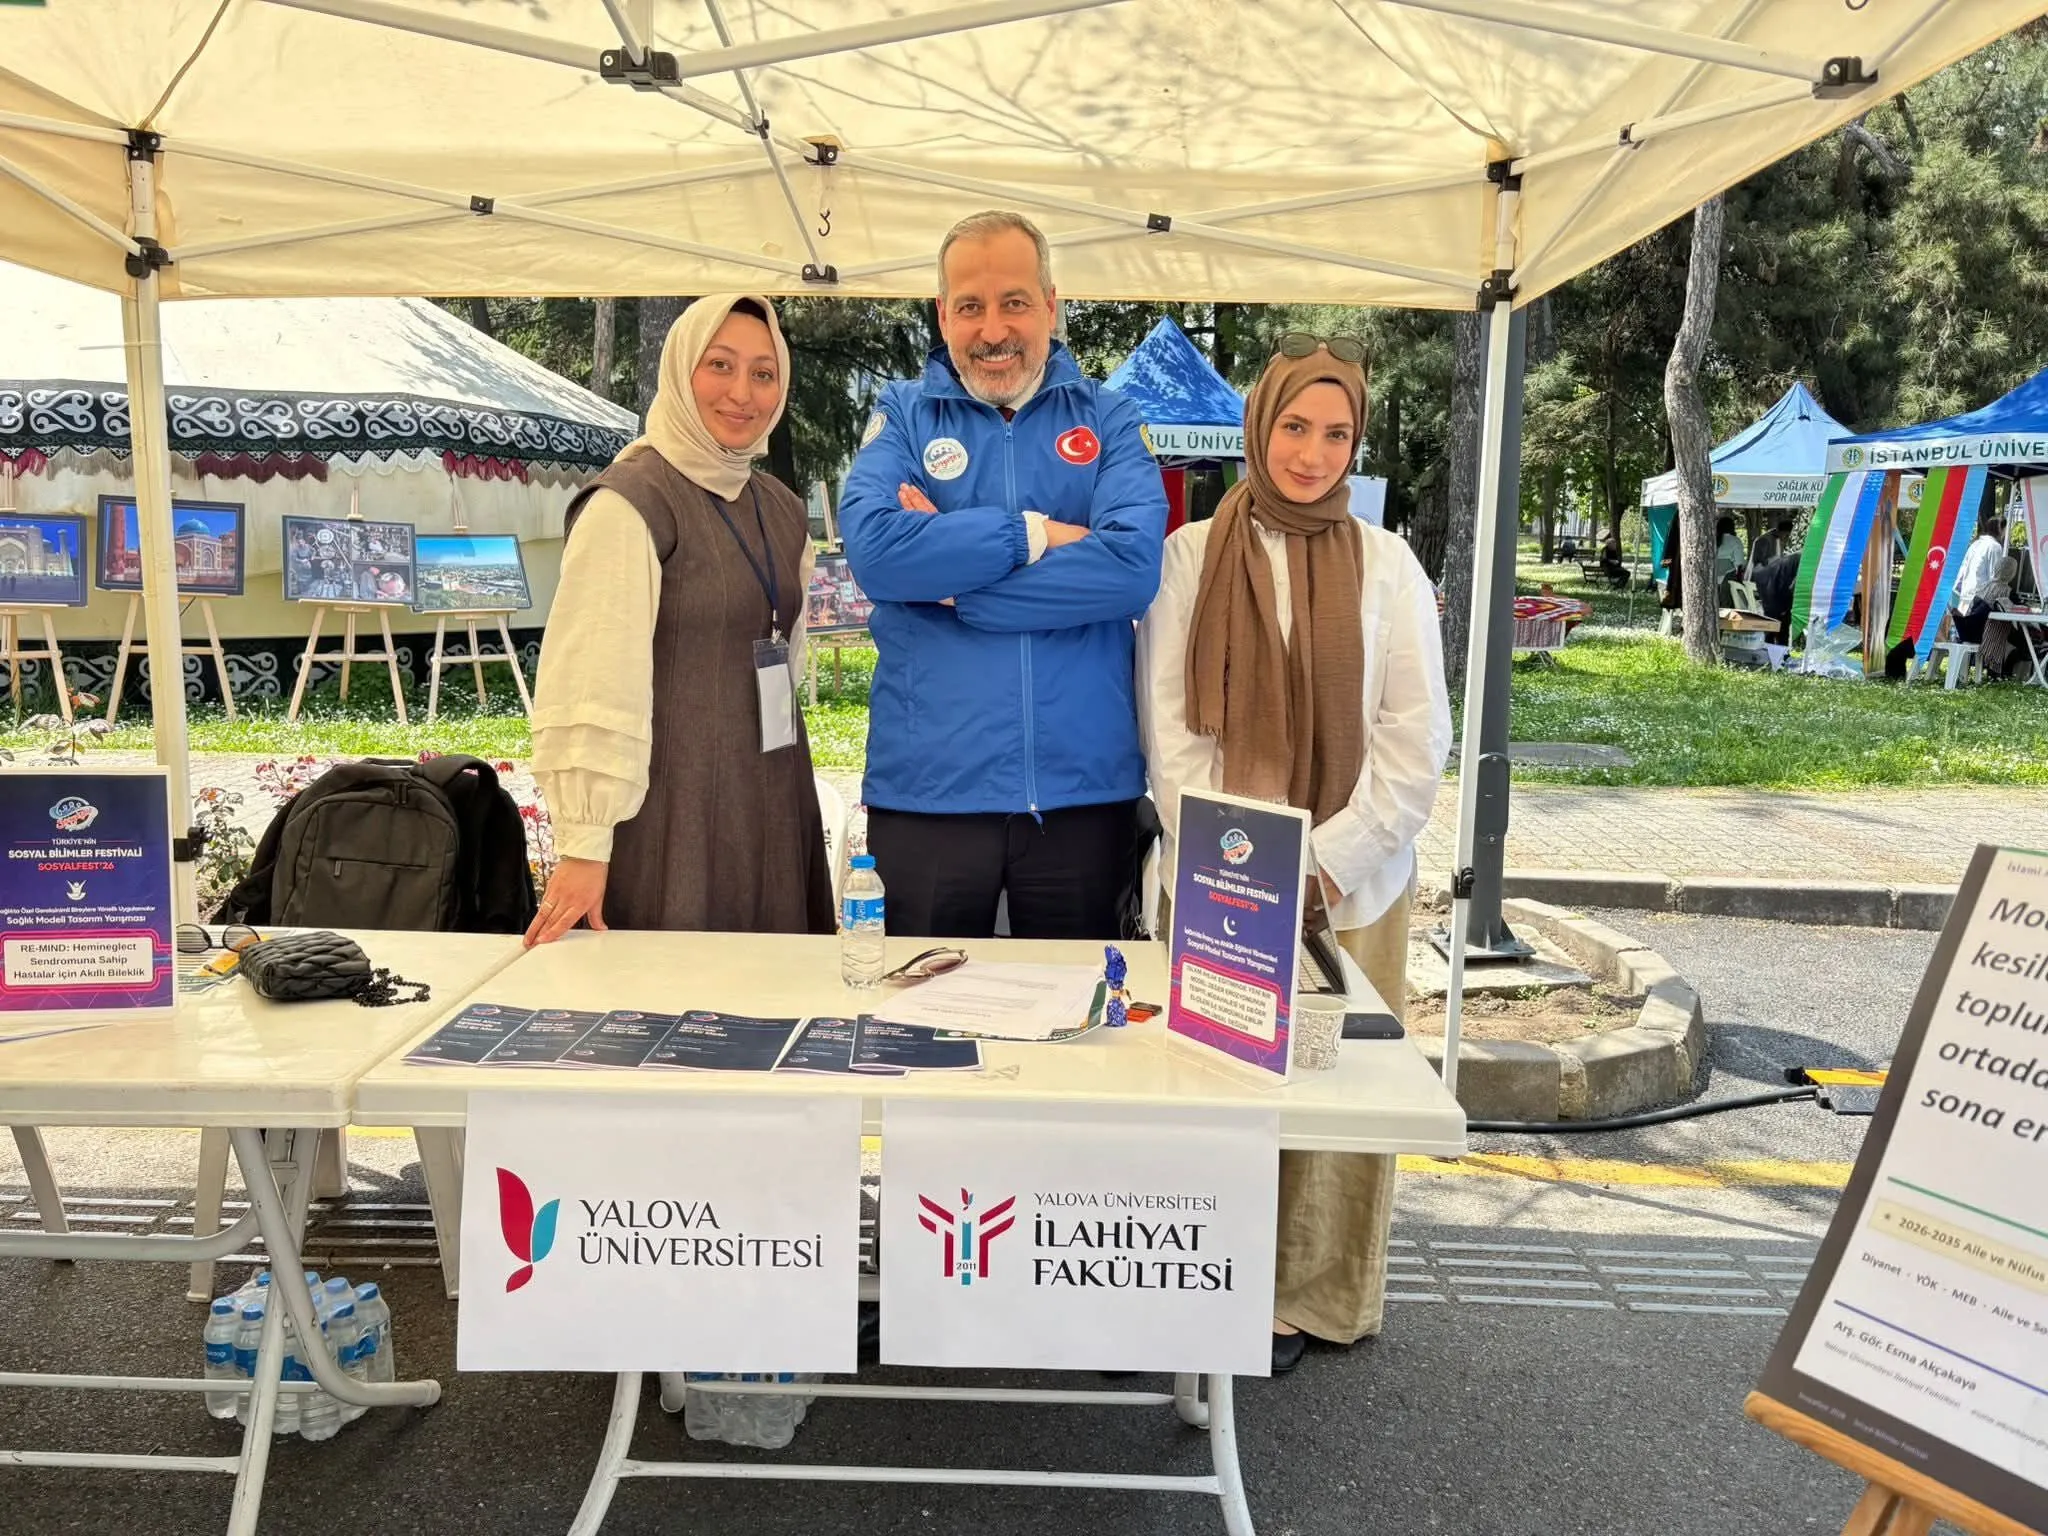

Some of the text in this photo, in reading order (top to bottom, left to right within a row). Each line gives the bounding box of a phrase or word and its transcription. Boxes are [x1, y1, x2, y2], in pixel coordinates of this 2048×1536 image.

[1870, 438, 2046, 465] İSTANBUL ÜNİVE
[1763, 491, 1788, 501] SPOR
[1776, 480, 1809, 491] SAĞLIK
[8, 847, 143, 859] SOSYAL BİLİMLER FESTİVALİ
[6, 916, 34, 926] Sağlık
[1989, 898, 2048, 930] Mo
[20, 942, 137, 953] RE-MIND: Hemineglect
[30, 955, 128, 966] Sendromuna Sahip
[13, 970, 55, 979] Hastalar
[58, 969, 77, 980] için
[107, 967, 145, 977] Bileklik
[1971, 941, 2048, 983] kesil
[1920, 1086, 2006, 1130] sona
[578, 1199, 721, 1229] YALOVA
[1033, 1191, 1217, 1211] YALOVA ÜNİVERSİTESİ
[1034, 1213, 1207, 1251] İLAHİYAT
[577, 1231, 824, 1268] ÜNİVERSİTESİ
[1898, 1216, 2045, 1282] 2026-2035 Aile ve Nüfus
[956, 1262, 976, 1270] 2011
[1033, 1255, 1234, 1292] FAKÜLTESİ
[1861, 1252, 1902, 1277] Diyanet
[1916, 1273, 1939, 1290] YÖK
[1951, 1289, 1977, 1306] MEB
[1991, 1306, 2014, 1321] Aile
[2017, 1316, 2031, 1328] ve
[1859, 1331, 1883, 1349] Gör.
[1885, 1343, 1917, 1364] Esma
[1919, 1359, 1977, 1391] Akçakaya
